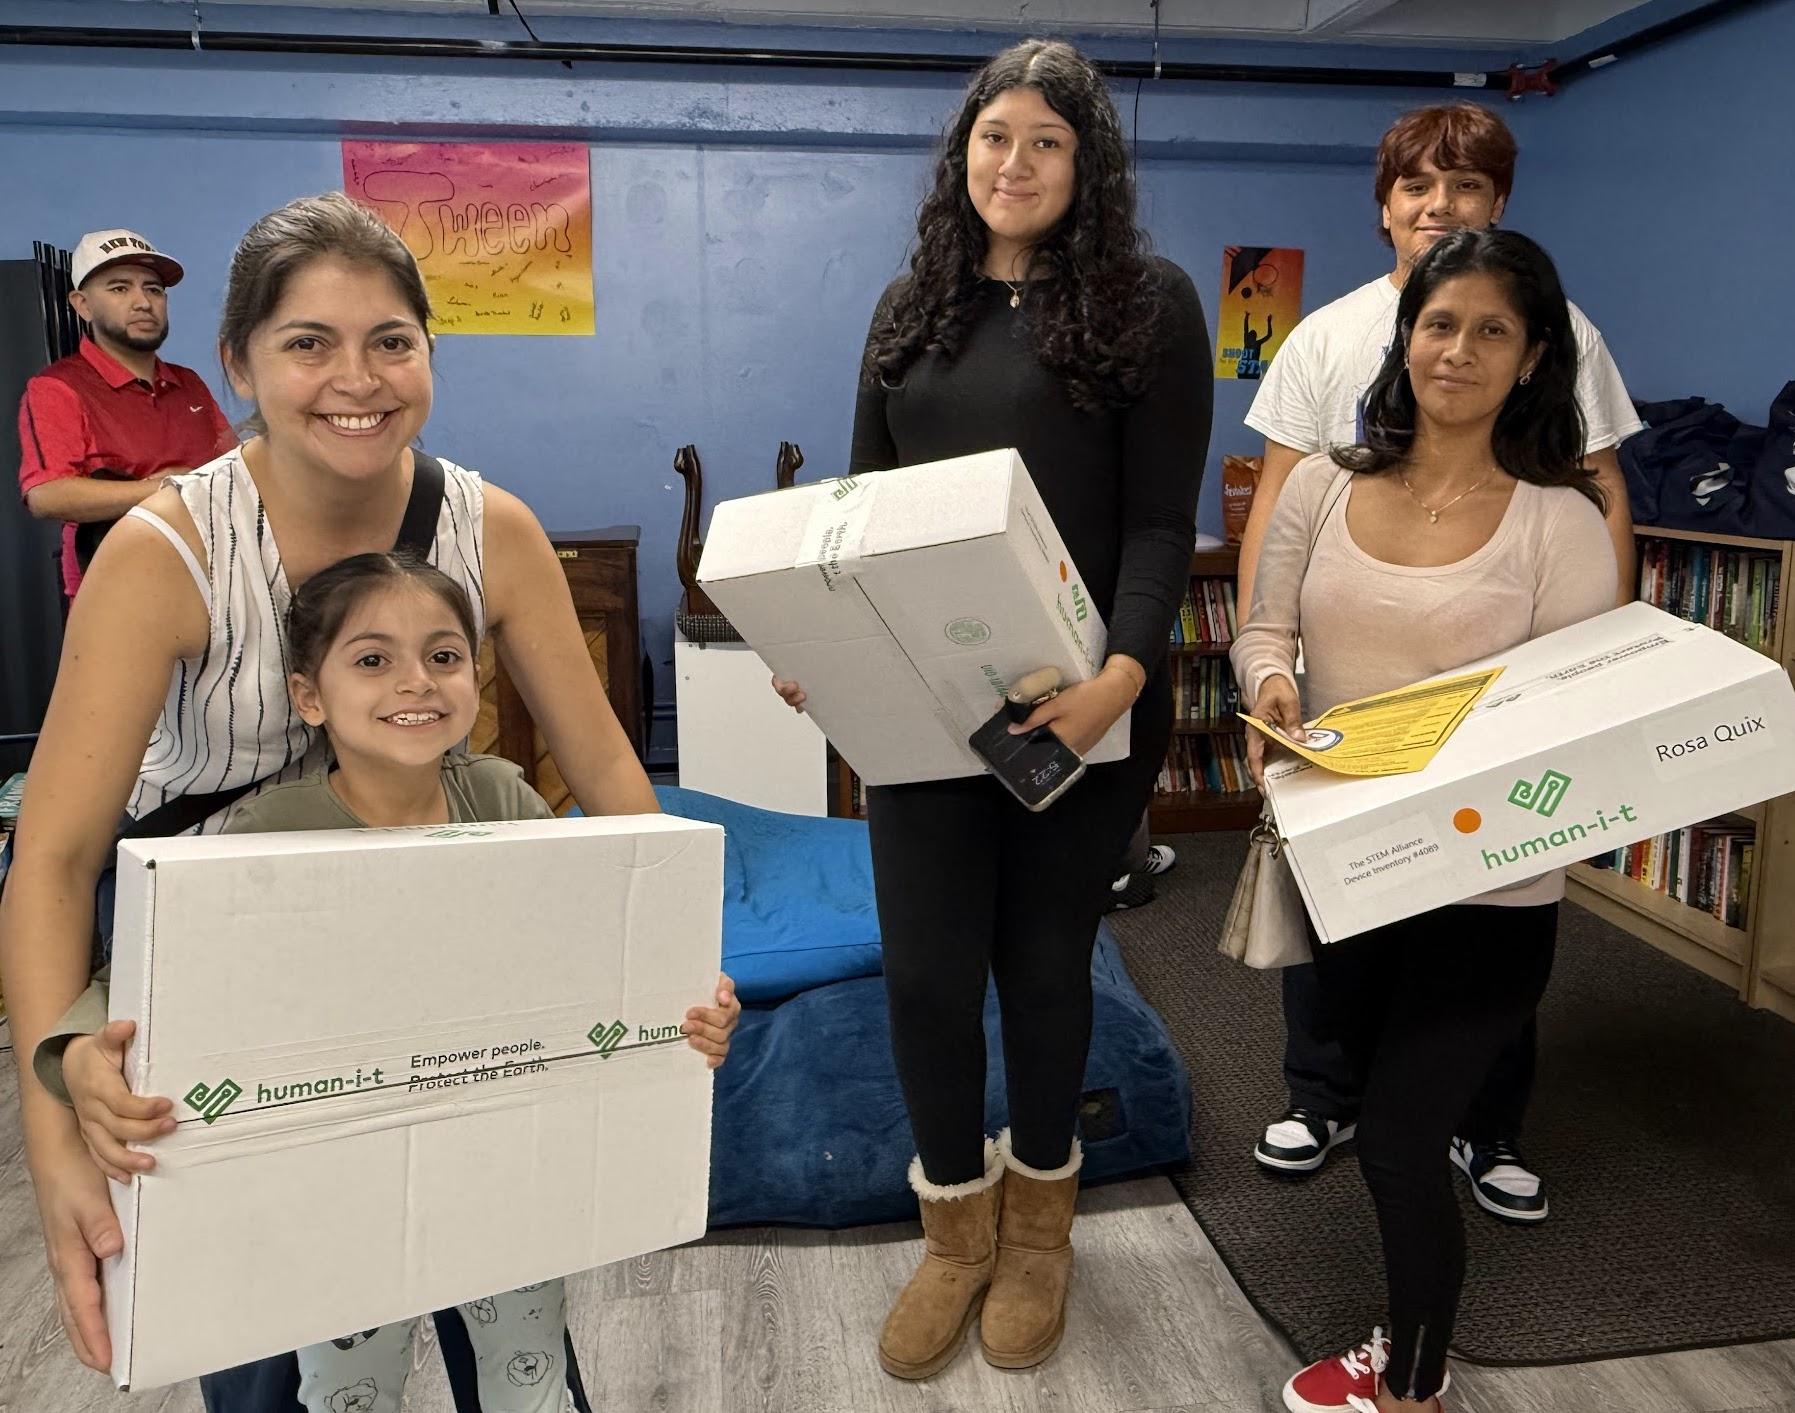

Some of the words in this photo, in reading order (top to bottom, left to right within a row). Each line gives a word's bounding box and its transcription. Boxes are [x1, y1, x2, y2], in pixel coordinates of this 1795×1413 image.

[99, 237, 128, 254] NEW
[129, 237, 156, 252] YOR
[1237, 360, 1271, 375] STA
[1655, 736, 1709, 762] Rosa
[1713, 716, 1766, 742] Quix
[1348, 860, 1366, 871] The
[1365, 849, 1390, 865] STEM
[1391, 837, 1423, 855] Alliance
[1481, 804, 1638, 870] human-i-t
[1343, 870, 1373, 886] Device
[1372, 855, 1412, 874] Inventory
[1412, 843, 1440, 859] #4089
[410, 1047, 488, 1069] Empower
[491, 1038, 546, 1061] people.
[256, 1067, 385, 1104] human-i-t
[408, 1069, 469, 1093] Protect
[471, 1064, 499, 1083] the
